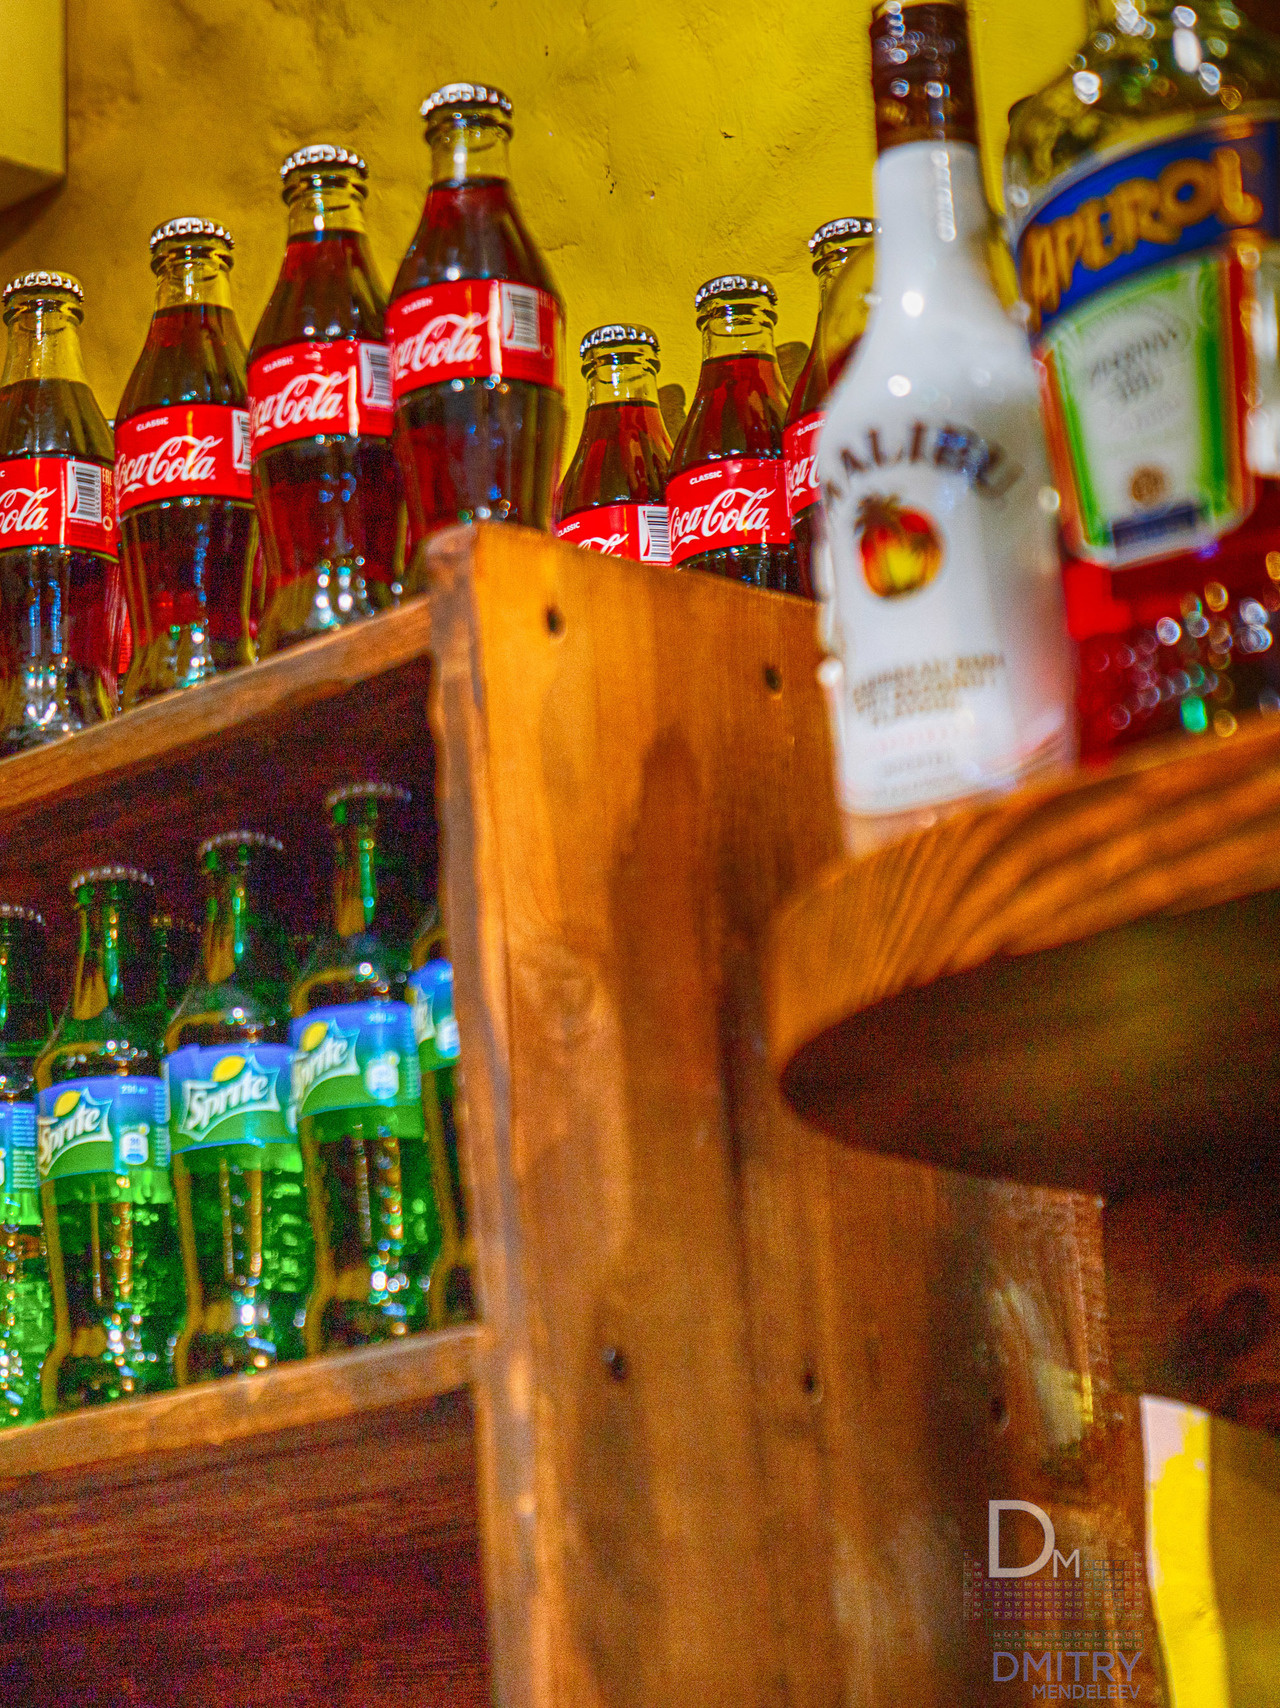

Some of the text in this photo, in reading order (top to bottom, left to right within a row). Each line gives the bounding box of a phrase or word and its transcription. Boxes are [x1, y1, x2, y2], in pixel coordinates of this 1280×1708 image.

[1027, 147, 1262, 331] APEROL
[136, 417, 170, 432] CLASSIC
[689, 470, 723, 485] CLASSIC
[557, 521, 581, 538] CLASSIC
[671, 487, 777, 553] Coca-Cola
[186, 1070, 270, 1130] Sprite
